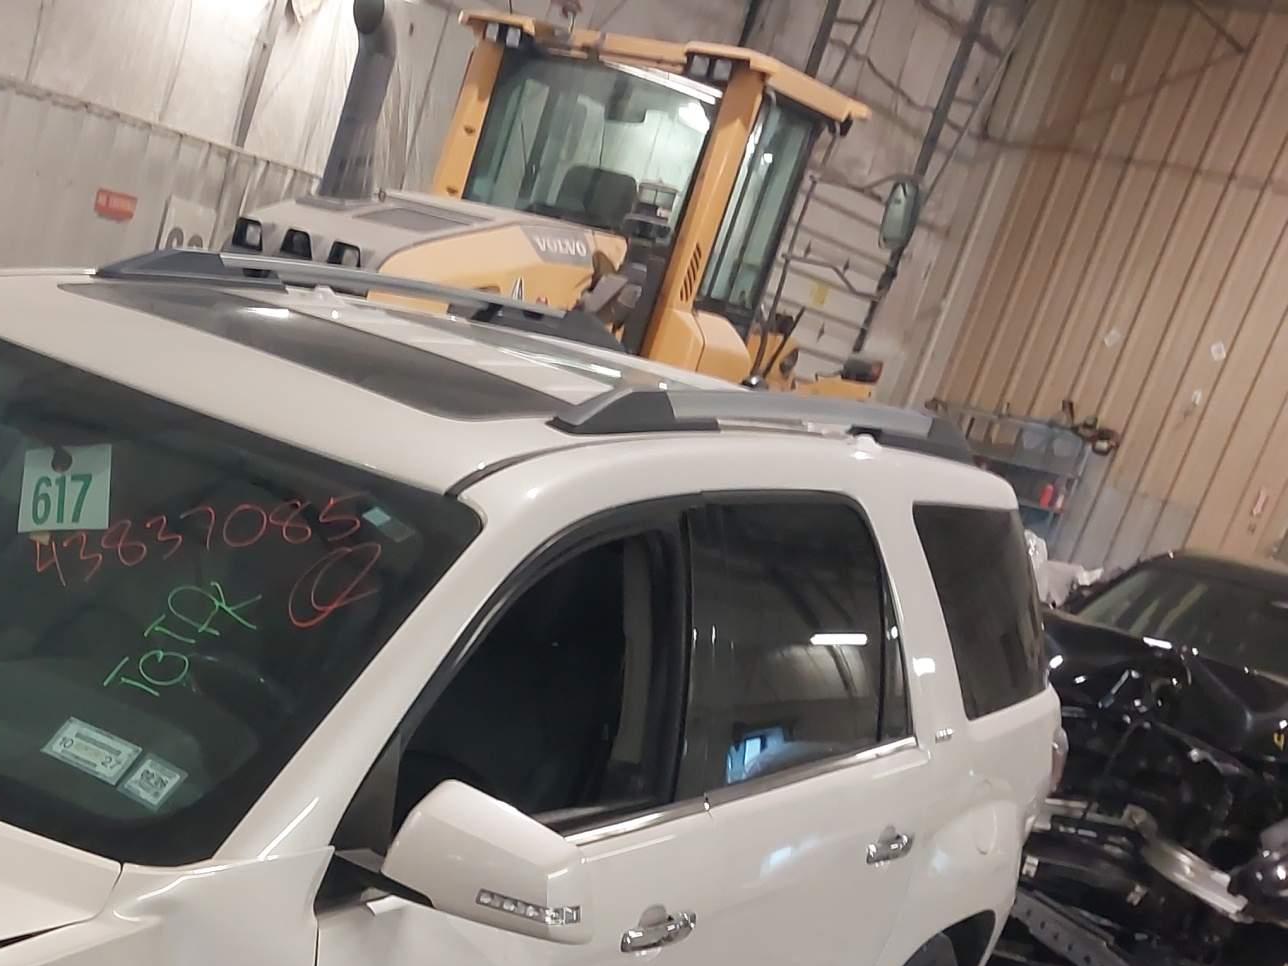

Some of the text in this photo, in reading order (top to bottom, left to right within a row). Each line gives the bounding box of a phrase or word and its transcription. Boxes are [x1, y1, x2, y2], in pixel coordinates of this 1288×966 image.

[533, 236, 587, 257] VOLVO
[31, 473, 93, 525] 617
[31, 495, 369, 587] 43837085
